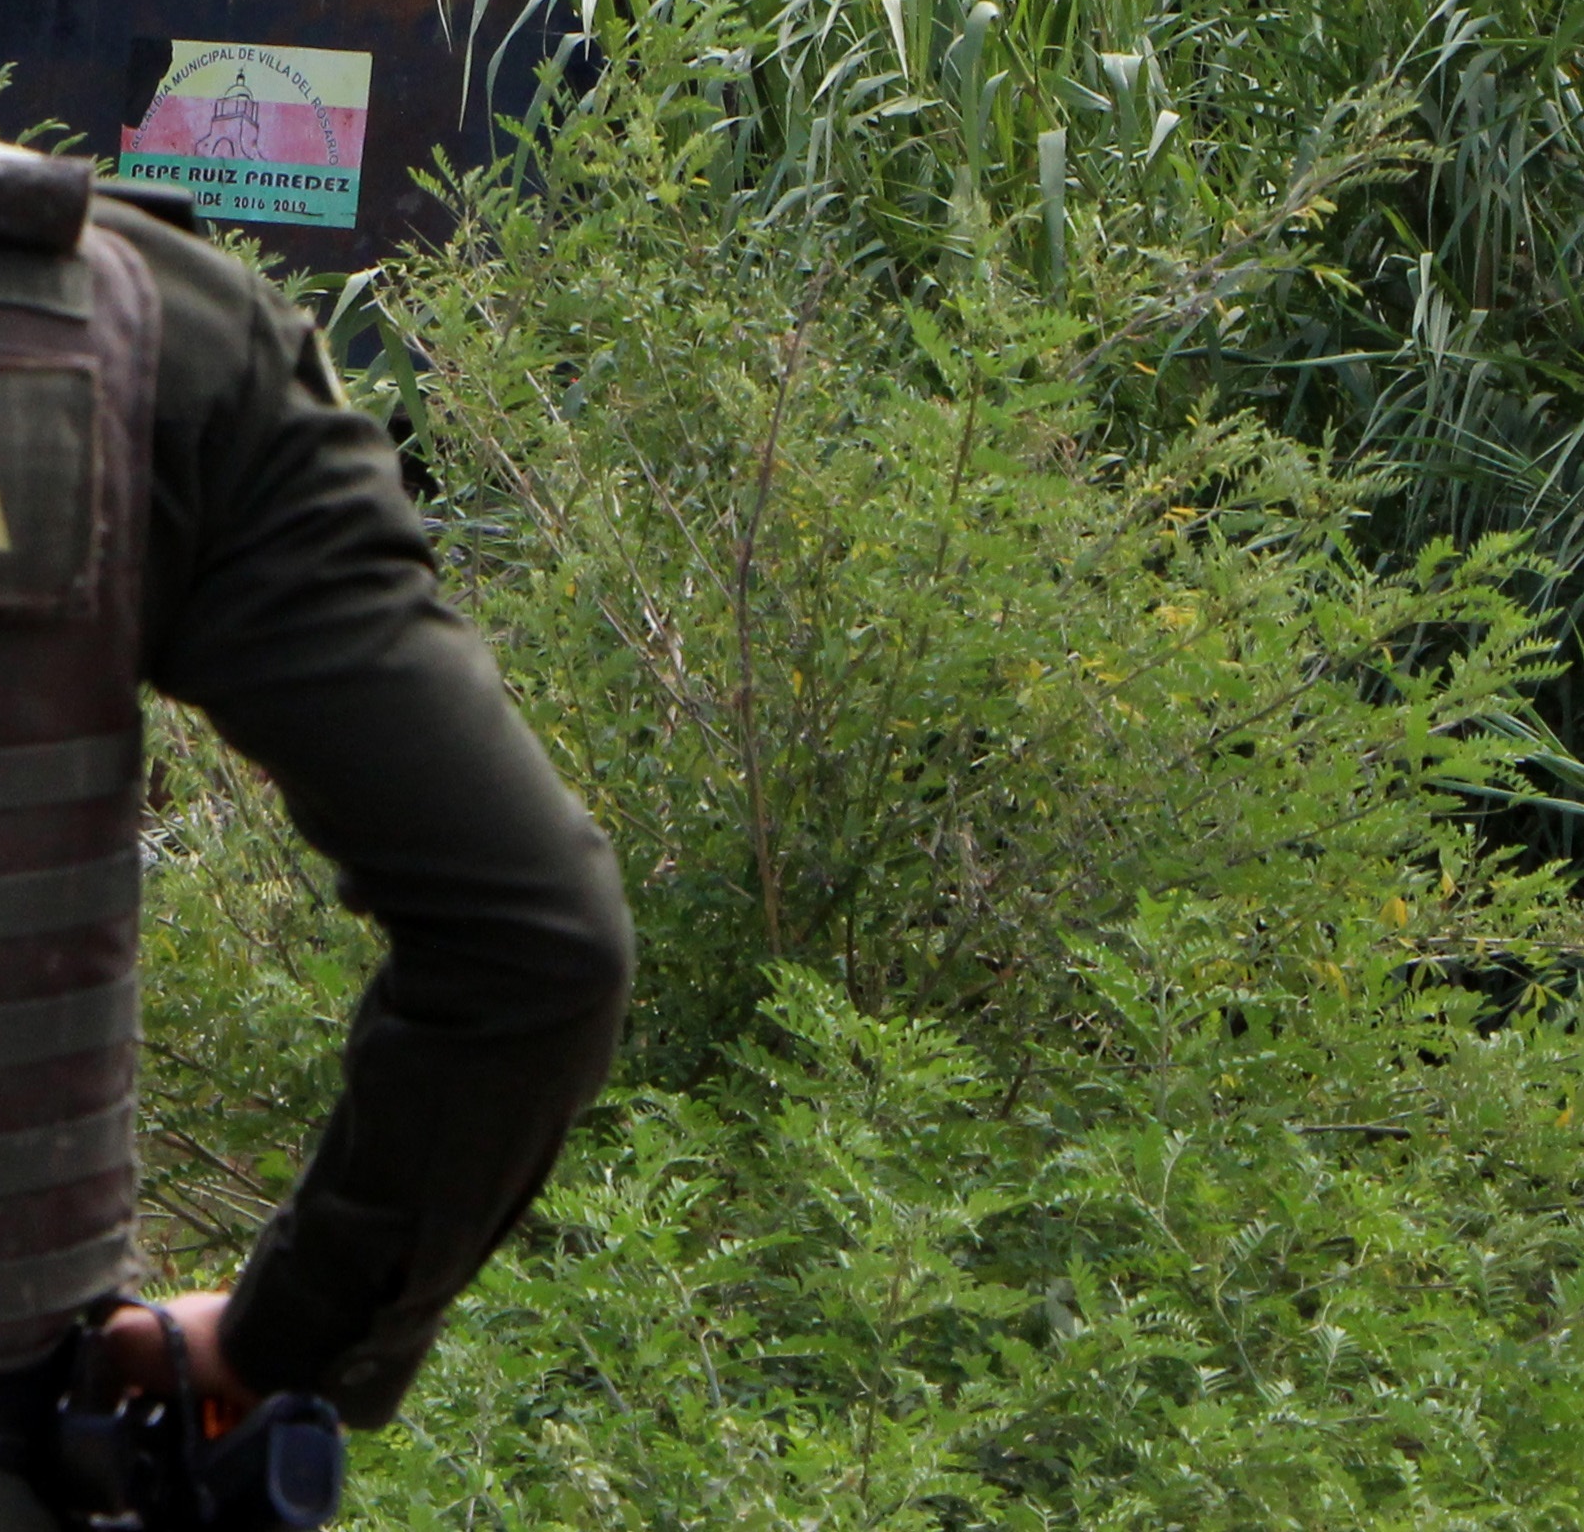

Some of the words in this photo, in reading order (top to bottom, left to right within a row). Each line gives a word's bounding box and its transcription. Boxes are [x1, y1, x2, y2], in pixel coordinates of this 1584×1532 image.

[171, 48, 235, 86] MUNICIPAL
[238, 47, 256, 61] DE
[259, 51, 291, 78] VILLA
[291, 72, 312, 100] DEL
[311, 96, 339, 166] ROSARIO
[131, 163, 181, 180] PEPE
[188, 166, 238, 184] RUIZ
[244, 170, 350, 193] PAREDEZ
[234, 196, 266, 210] 2016
